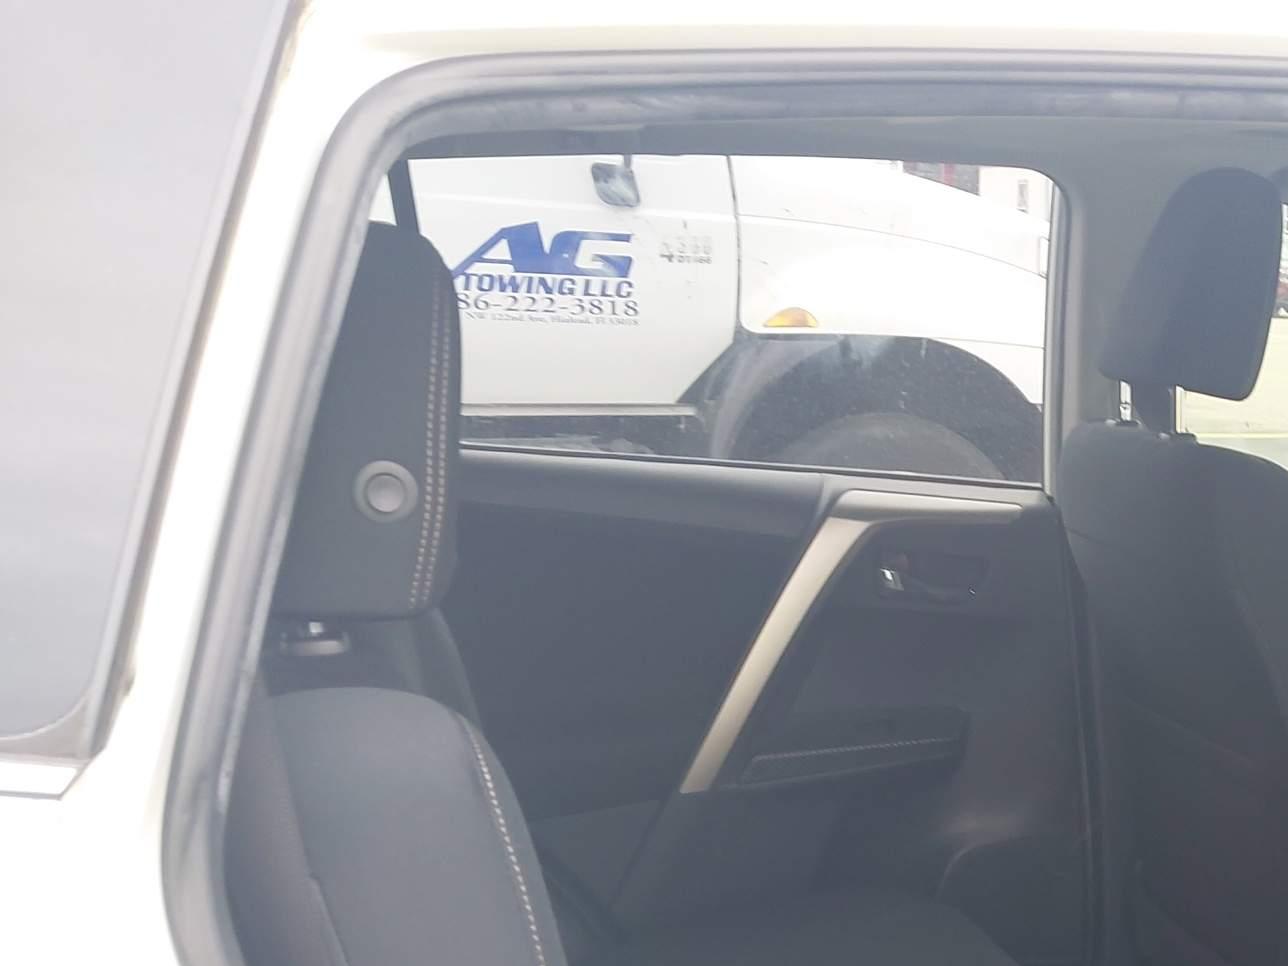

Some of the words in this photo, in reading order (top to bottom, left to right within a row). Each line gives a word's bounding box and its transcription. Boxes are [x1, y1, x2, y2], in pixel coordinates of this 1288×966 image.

[450, 221, 633, 278] AG
[462, 273, 576, 296] TOWING
[583, 278, 633, 299] LLC
